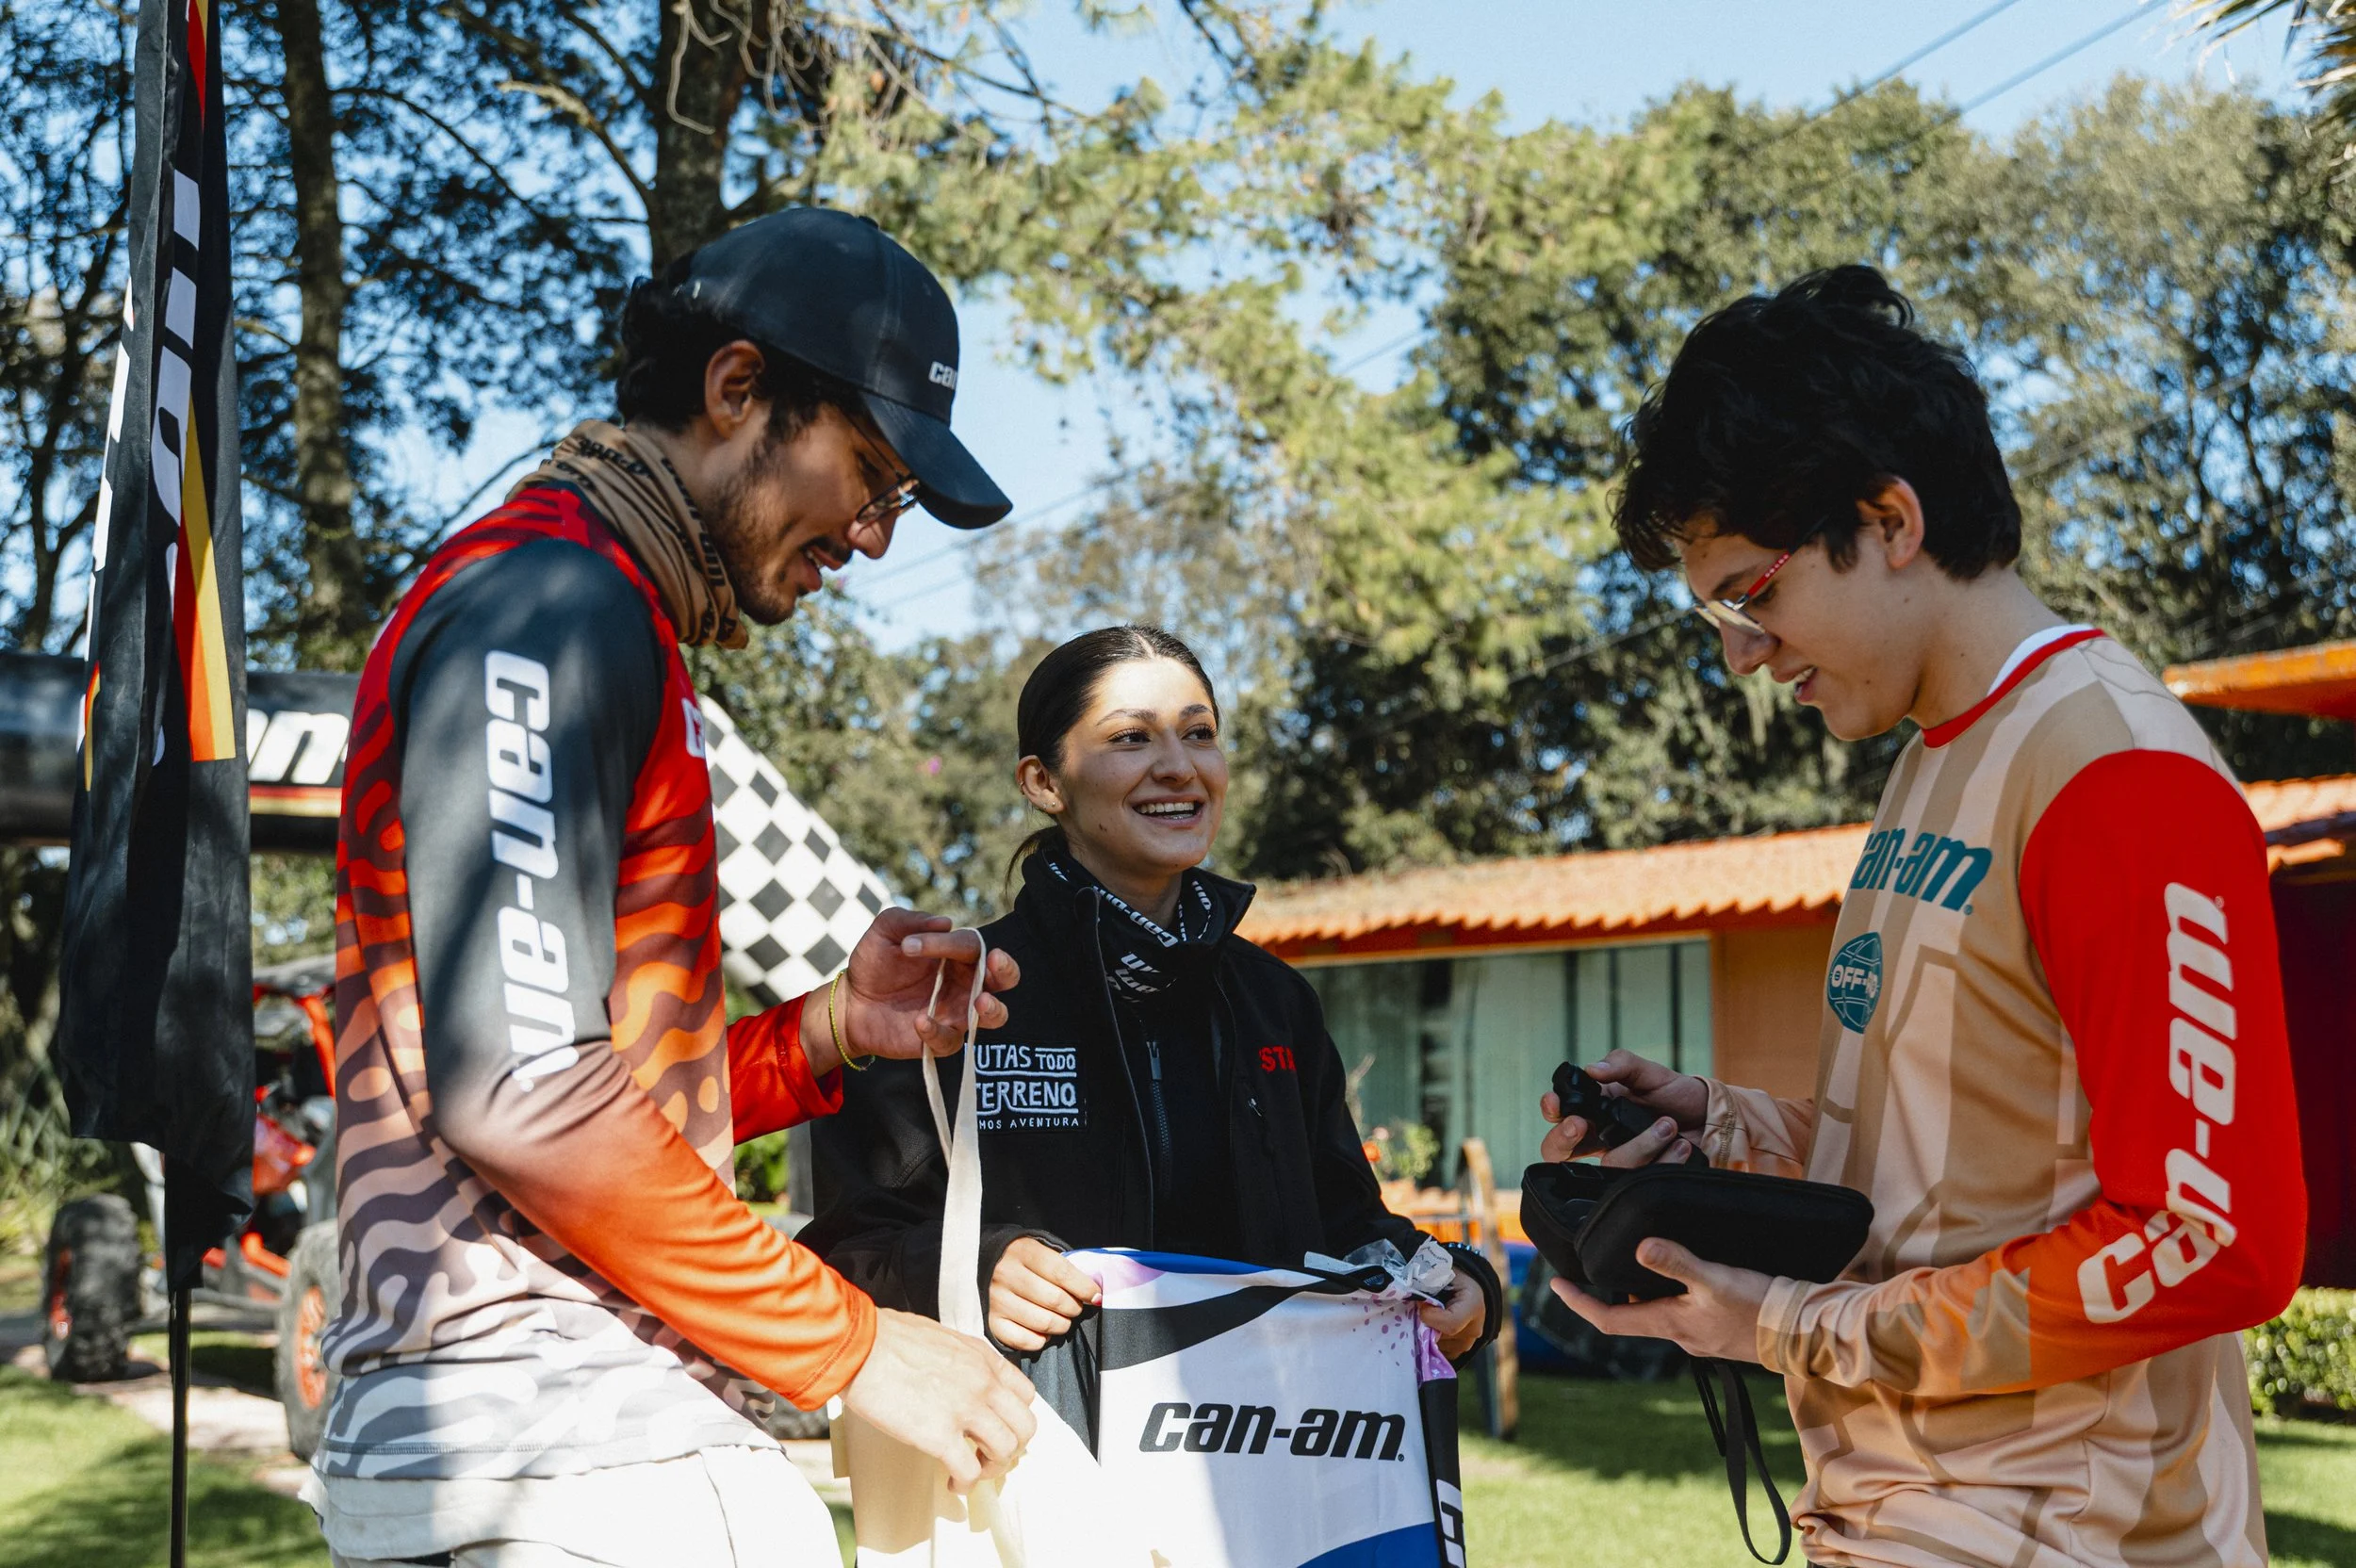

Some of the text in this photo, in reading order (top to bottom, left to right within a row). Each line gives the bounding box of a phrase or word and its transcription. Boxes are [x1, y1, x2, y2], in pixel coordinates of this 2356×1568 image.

[1850, 827, 1993, 912] an-am
[964, 1042, 1077, 1070] UTAS TODO
[1009, 1117, 1080, 1129] AVENTURA
[2076, 881, 2237, 1324] can-am
[1138, 1402, 1407, 1462] can-am
